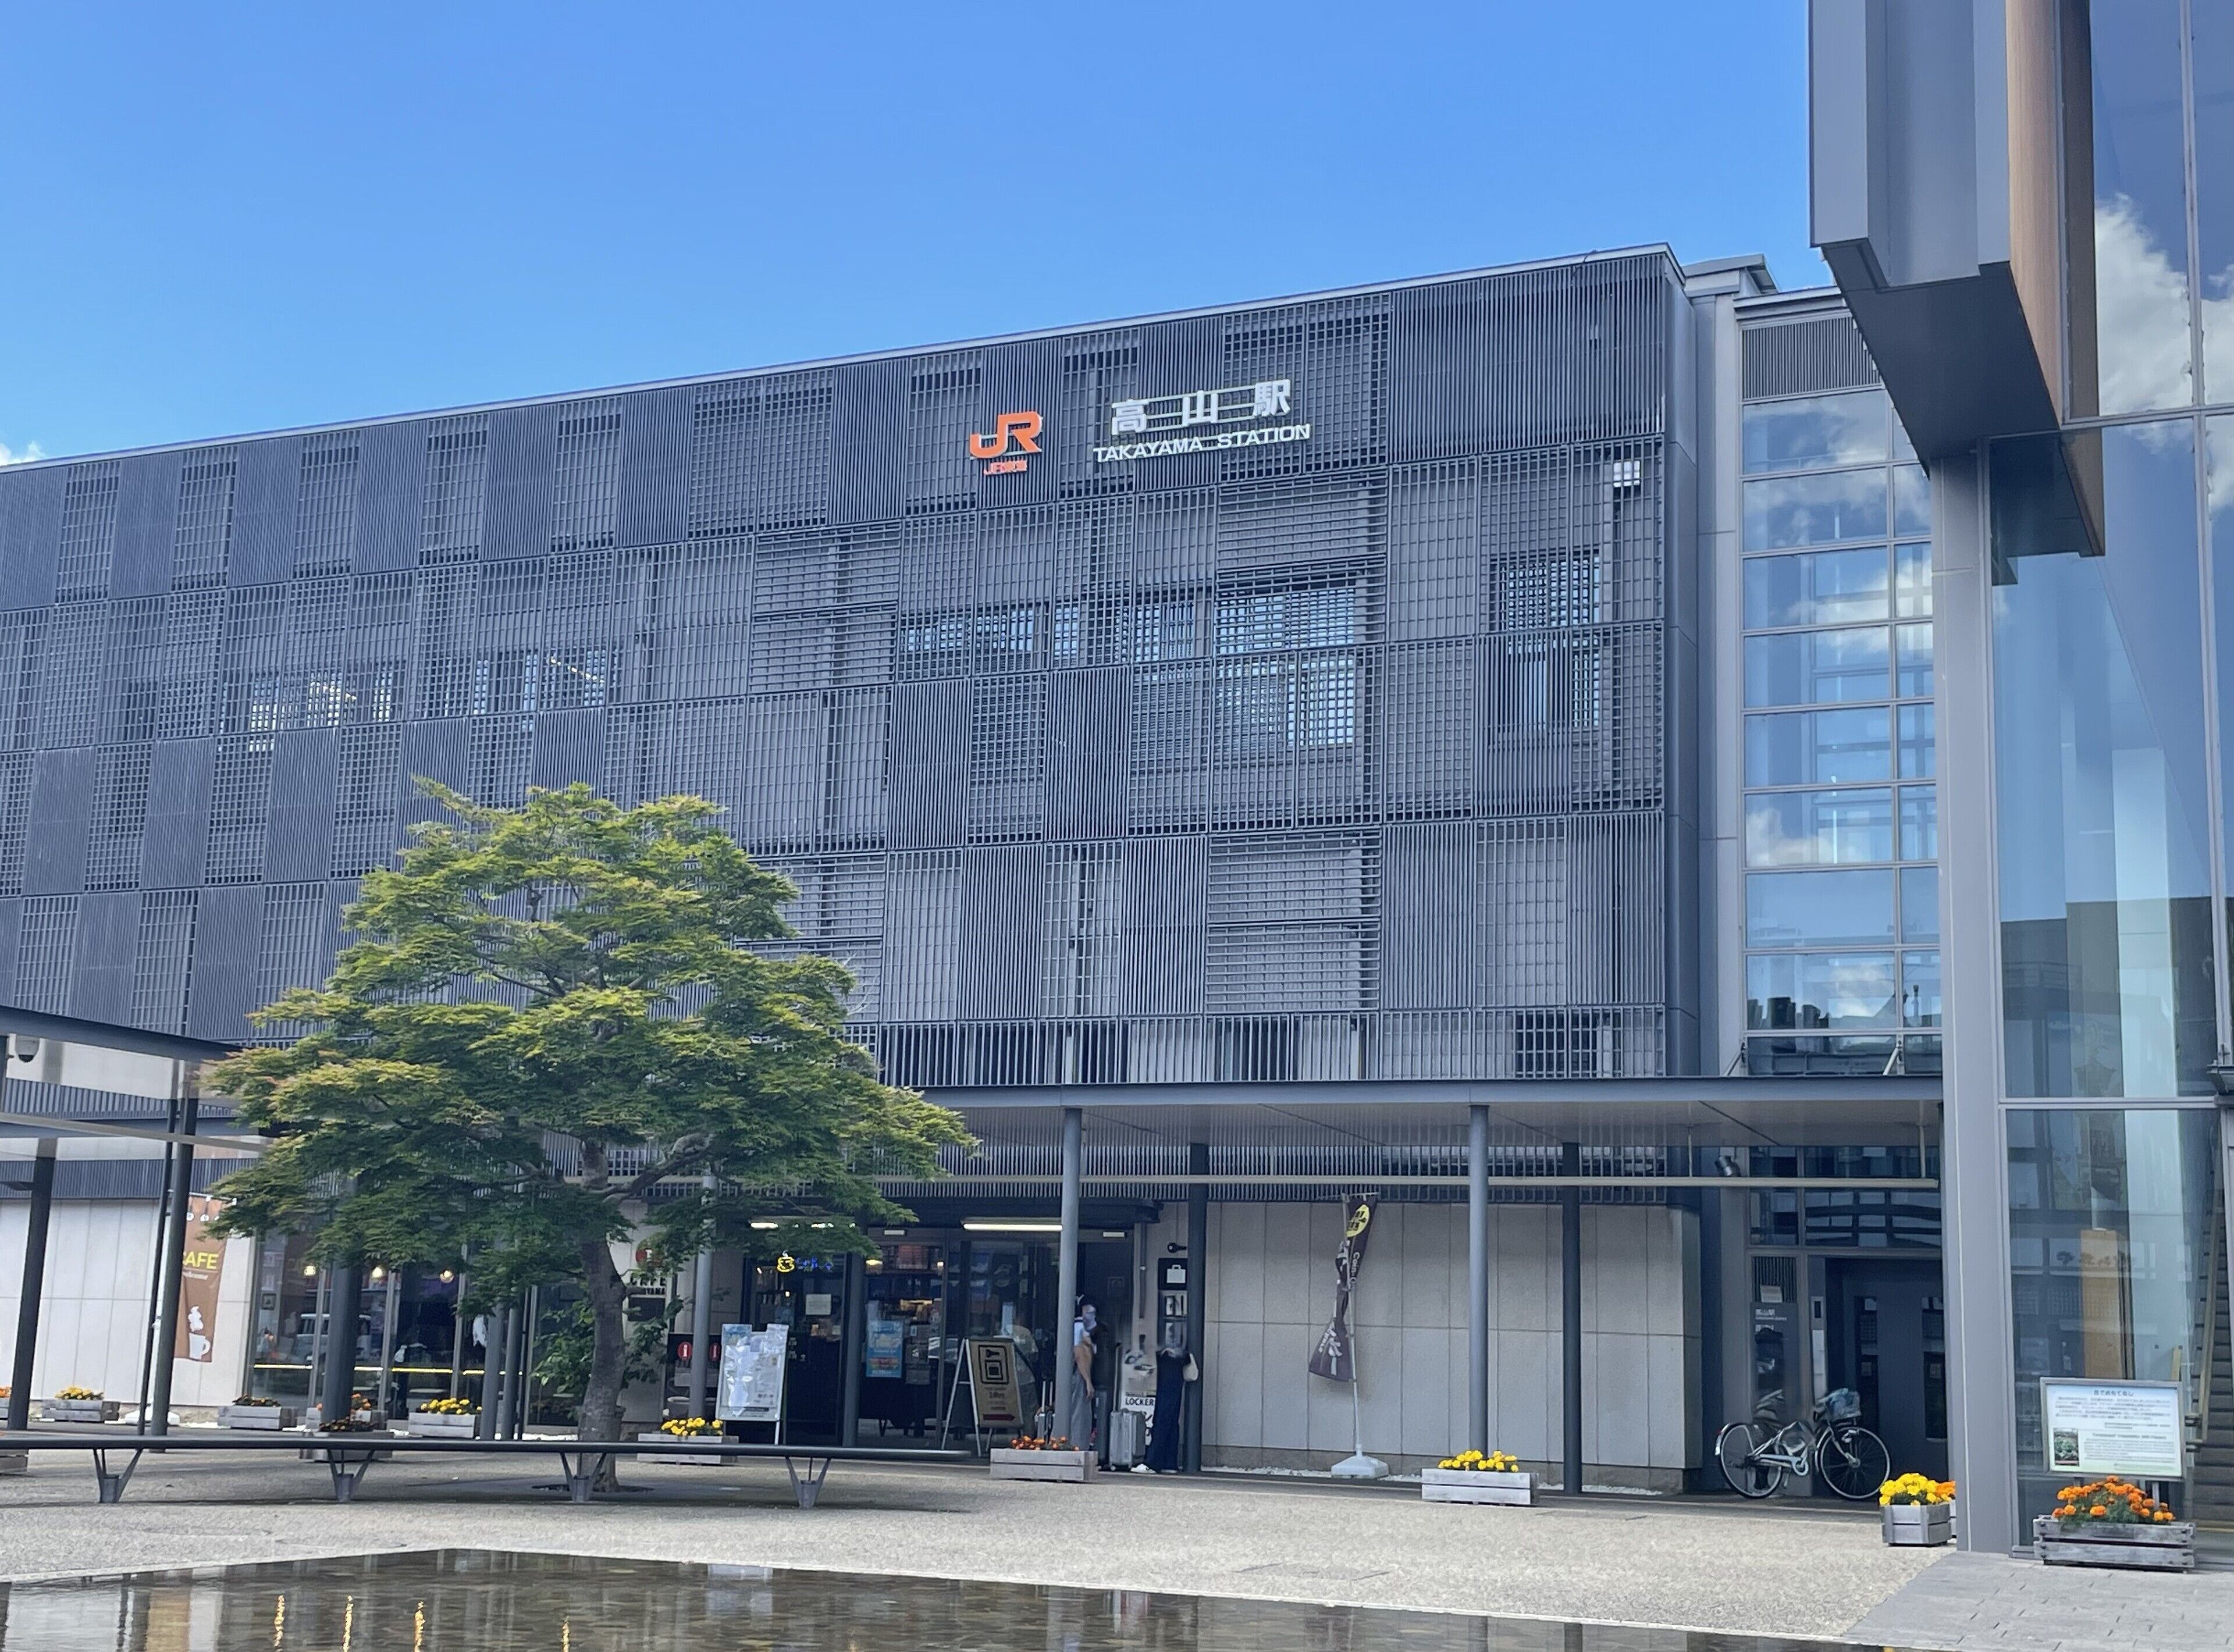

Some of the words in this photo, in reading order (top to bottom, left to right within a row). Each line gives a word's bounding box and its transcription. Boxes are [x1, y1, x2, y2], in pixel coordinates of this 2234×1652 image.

[1112, 379, 1291, 435] 高山駅
[970, 411, 1043, 458] JR
[1093, 436, 1204, 463] TAKAYAMA
[1217, 423, 1311, 449] STATION
[1125, 1397, 1154, 1406] LOCKER
